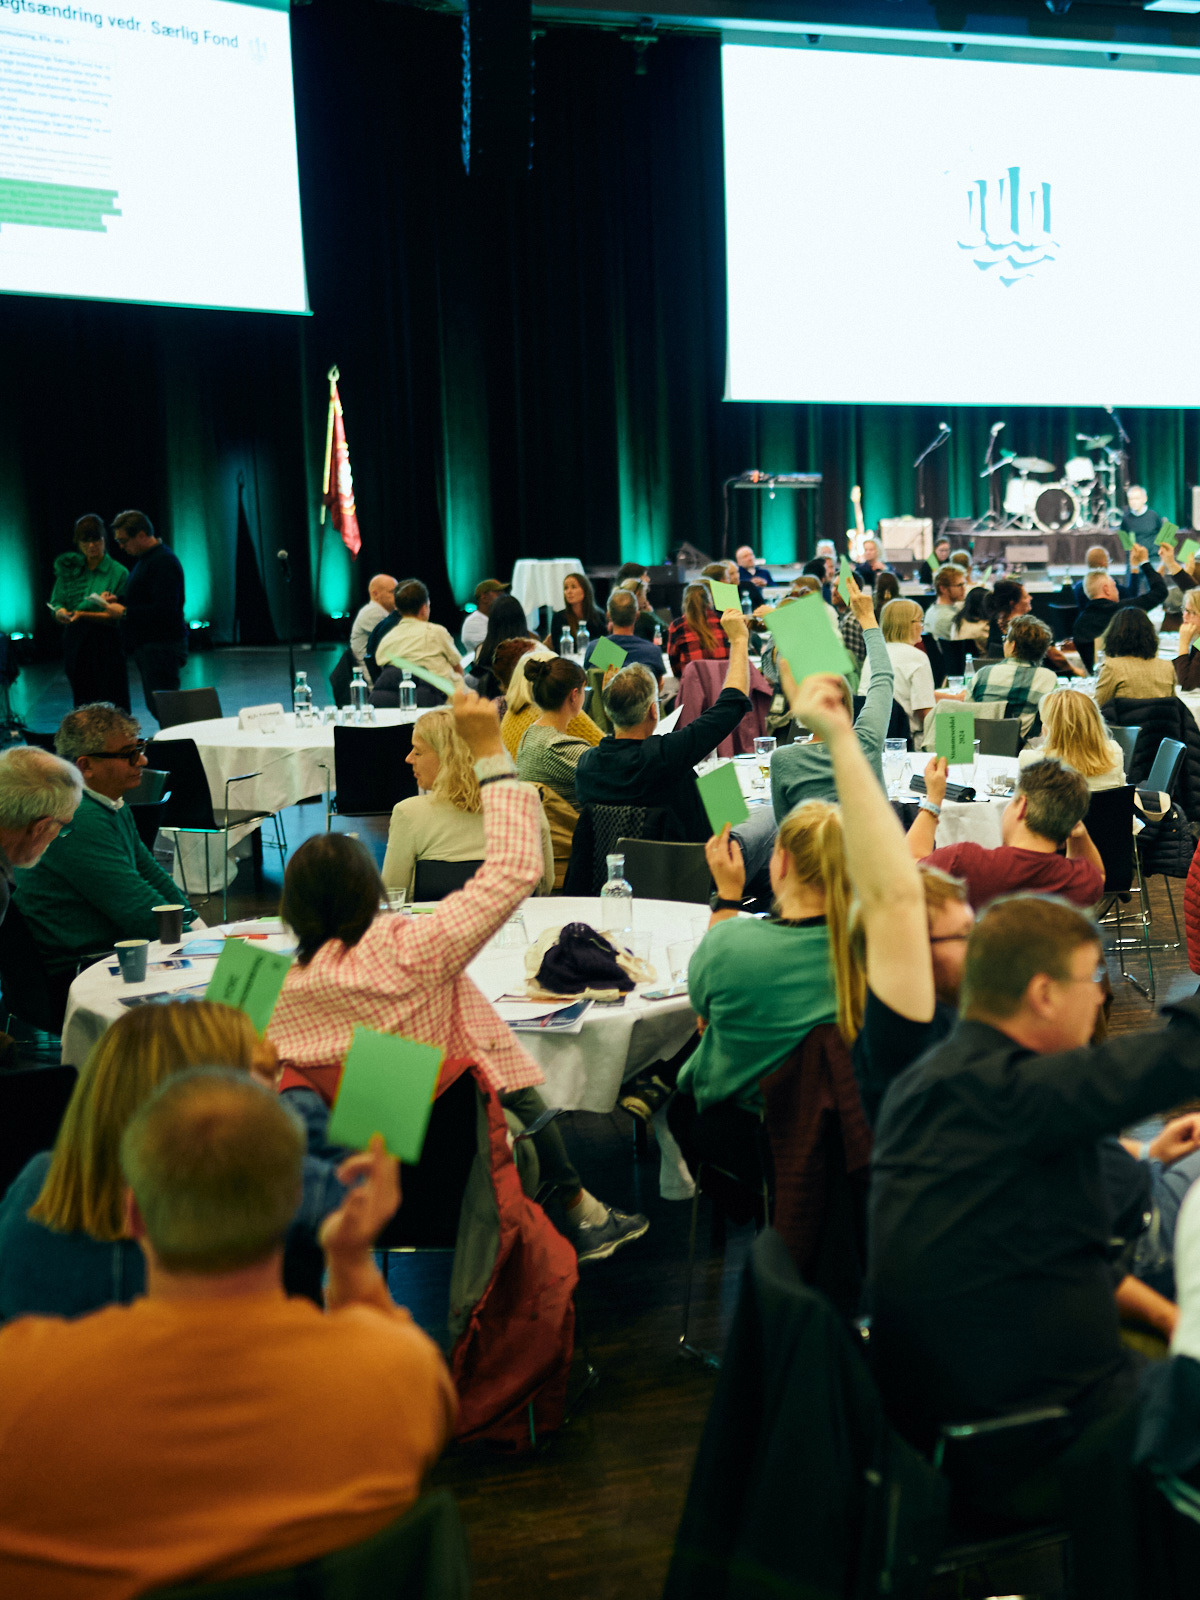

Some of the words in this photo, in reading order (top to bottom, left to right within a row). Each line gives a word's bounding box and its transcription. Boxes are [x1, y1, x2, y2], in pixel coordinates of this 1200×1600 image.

[107, 15, 146, 32] vedr.
[151, 20, 198, 45] Særlig
[204, 30, 239, 48] Fond
